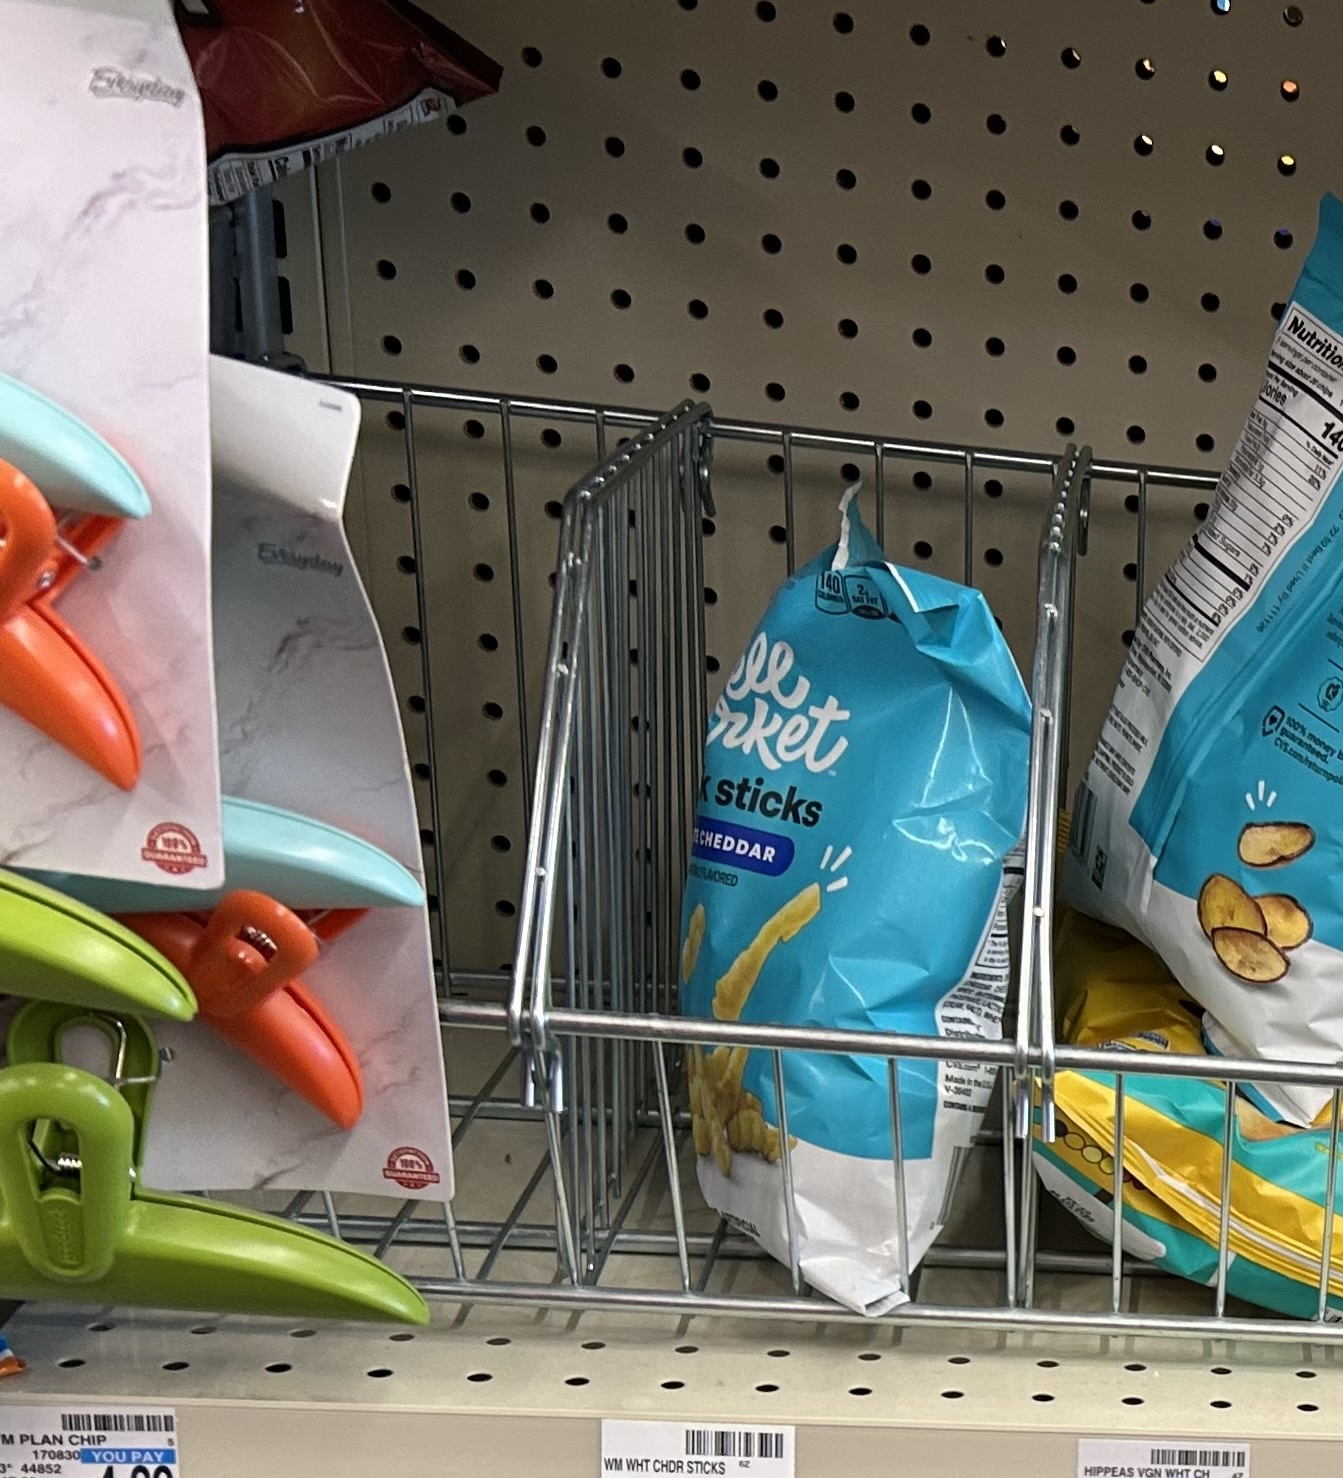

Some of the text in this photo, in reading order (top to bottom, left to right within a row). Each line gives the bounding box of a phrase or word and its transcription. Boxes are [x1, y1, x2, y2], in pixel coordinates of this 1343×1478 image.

[1279, 728, 1329, 764] guaranteed.
[715, 776, 823, 827] sticks
[700, 828, 776, 863] CHEDDAR
[32, 1450, 80, 1460] 170830
[92, 1451, 164, 1463] YOU PAY
[604, 1458, 725, 1475] WM WHT CHDR STICKS
[1084, 1466, 1210, 1478] HIPPEAS VGN WHT CH
